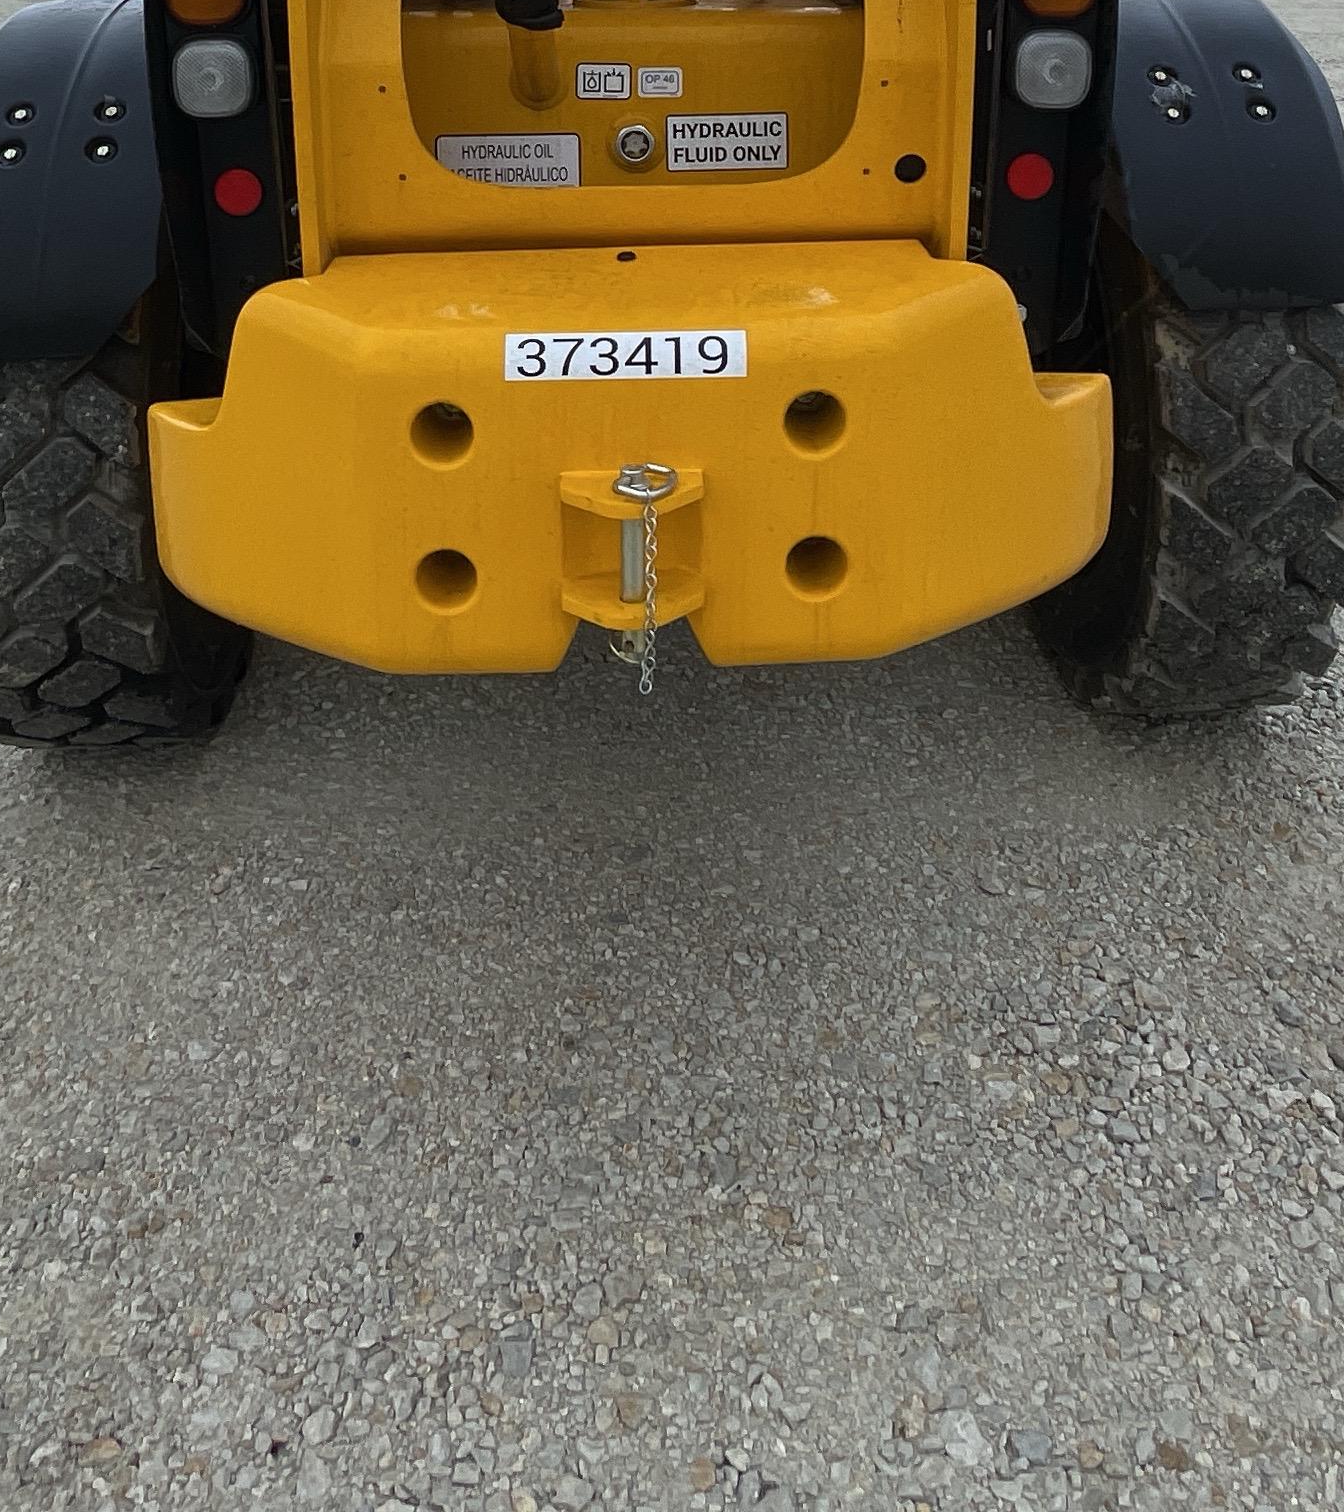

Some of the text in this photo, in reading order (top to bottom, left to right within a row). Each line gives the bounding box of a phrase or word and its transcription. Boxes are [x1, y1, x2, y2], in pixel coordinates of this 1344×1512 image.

[645, 74, 661, 84] OP
[672, 121, 783, 139] HYDRAULIC
[461, 143, 554, 159] HYDRAULIC OIL
[673, 145, 782, 163] FLUID ONLY
[450, 168, 492, 183] CEITE
[517, 335, 729, 378] 373419
